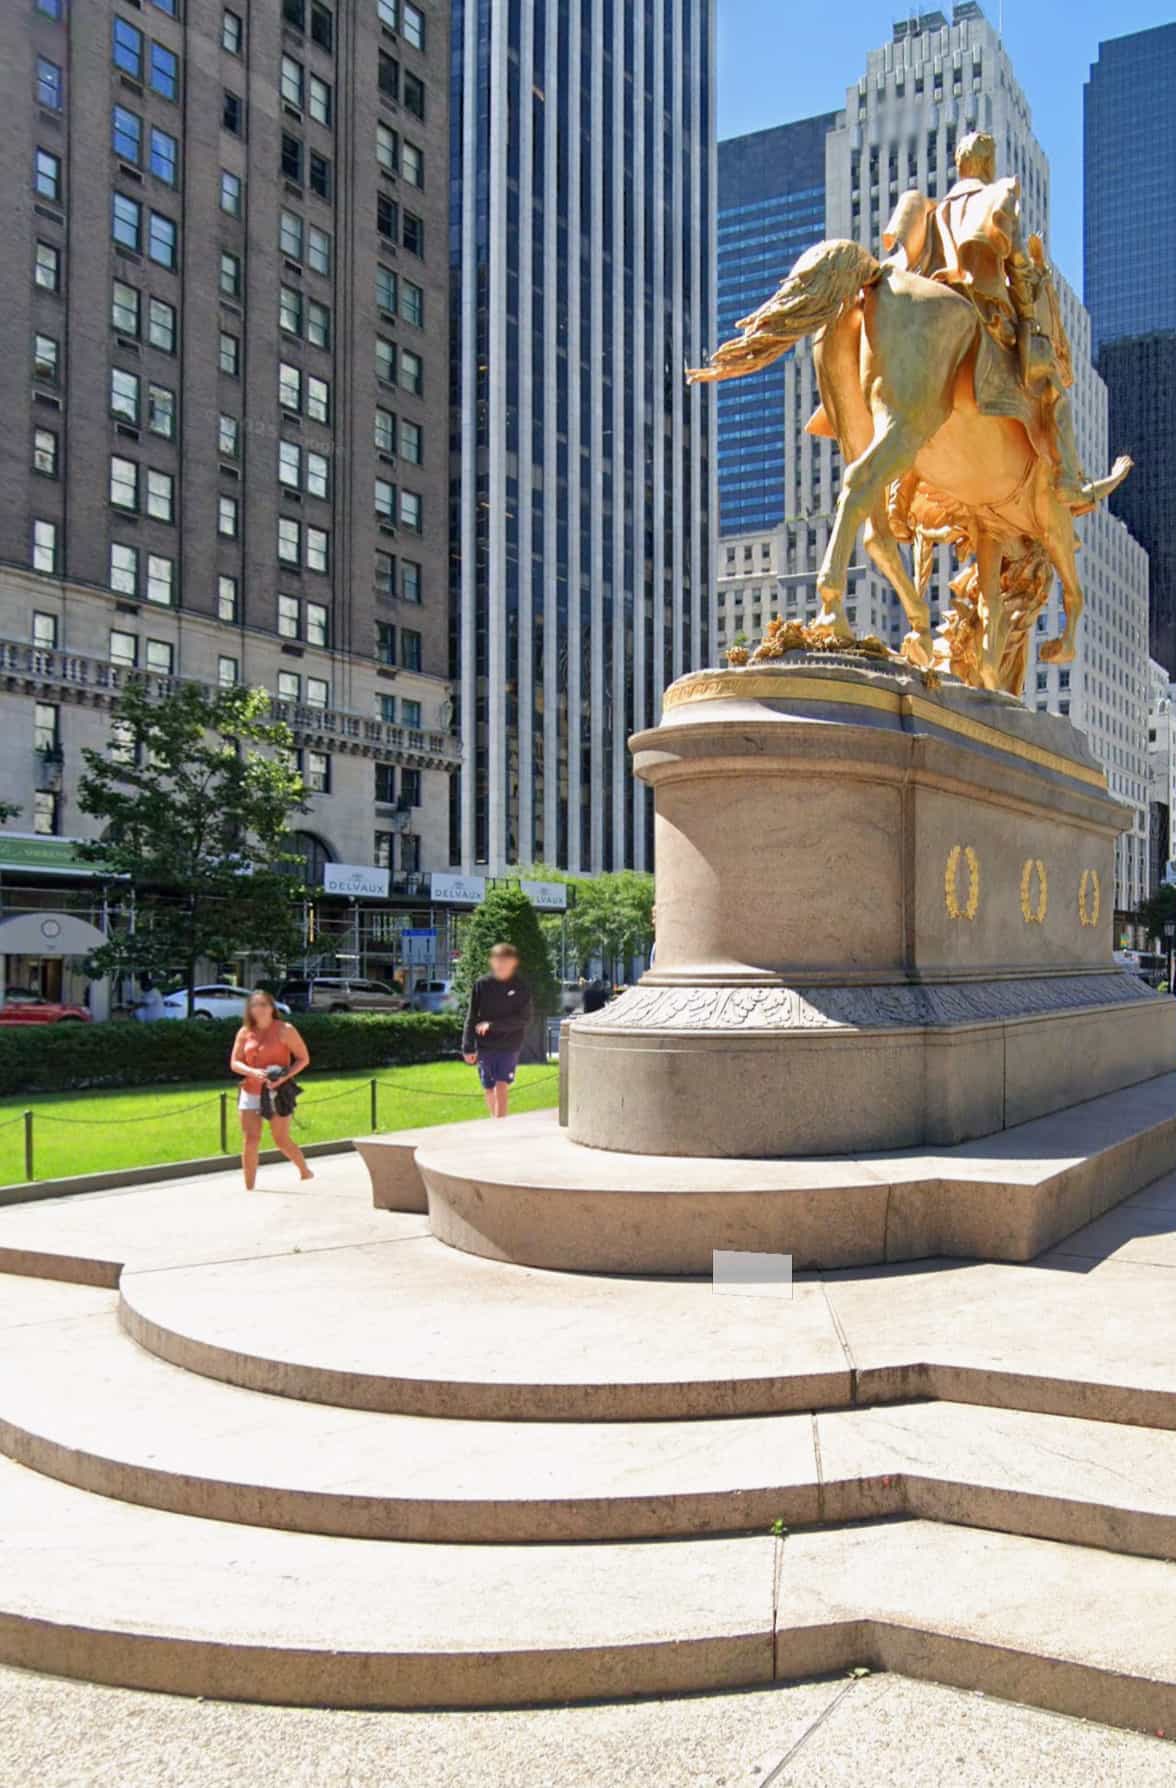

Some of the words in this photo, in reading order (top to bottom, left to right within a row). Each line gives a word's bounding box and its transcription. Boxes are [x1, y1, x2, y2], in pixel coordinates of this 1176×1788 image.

[328, 880, 385, 894] DELVAUX
[434, 888, 482, 900] DELVAUX
[536, 895, 563, 905] LVAUX
